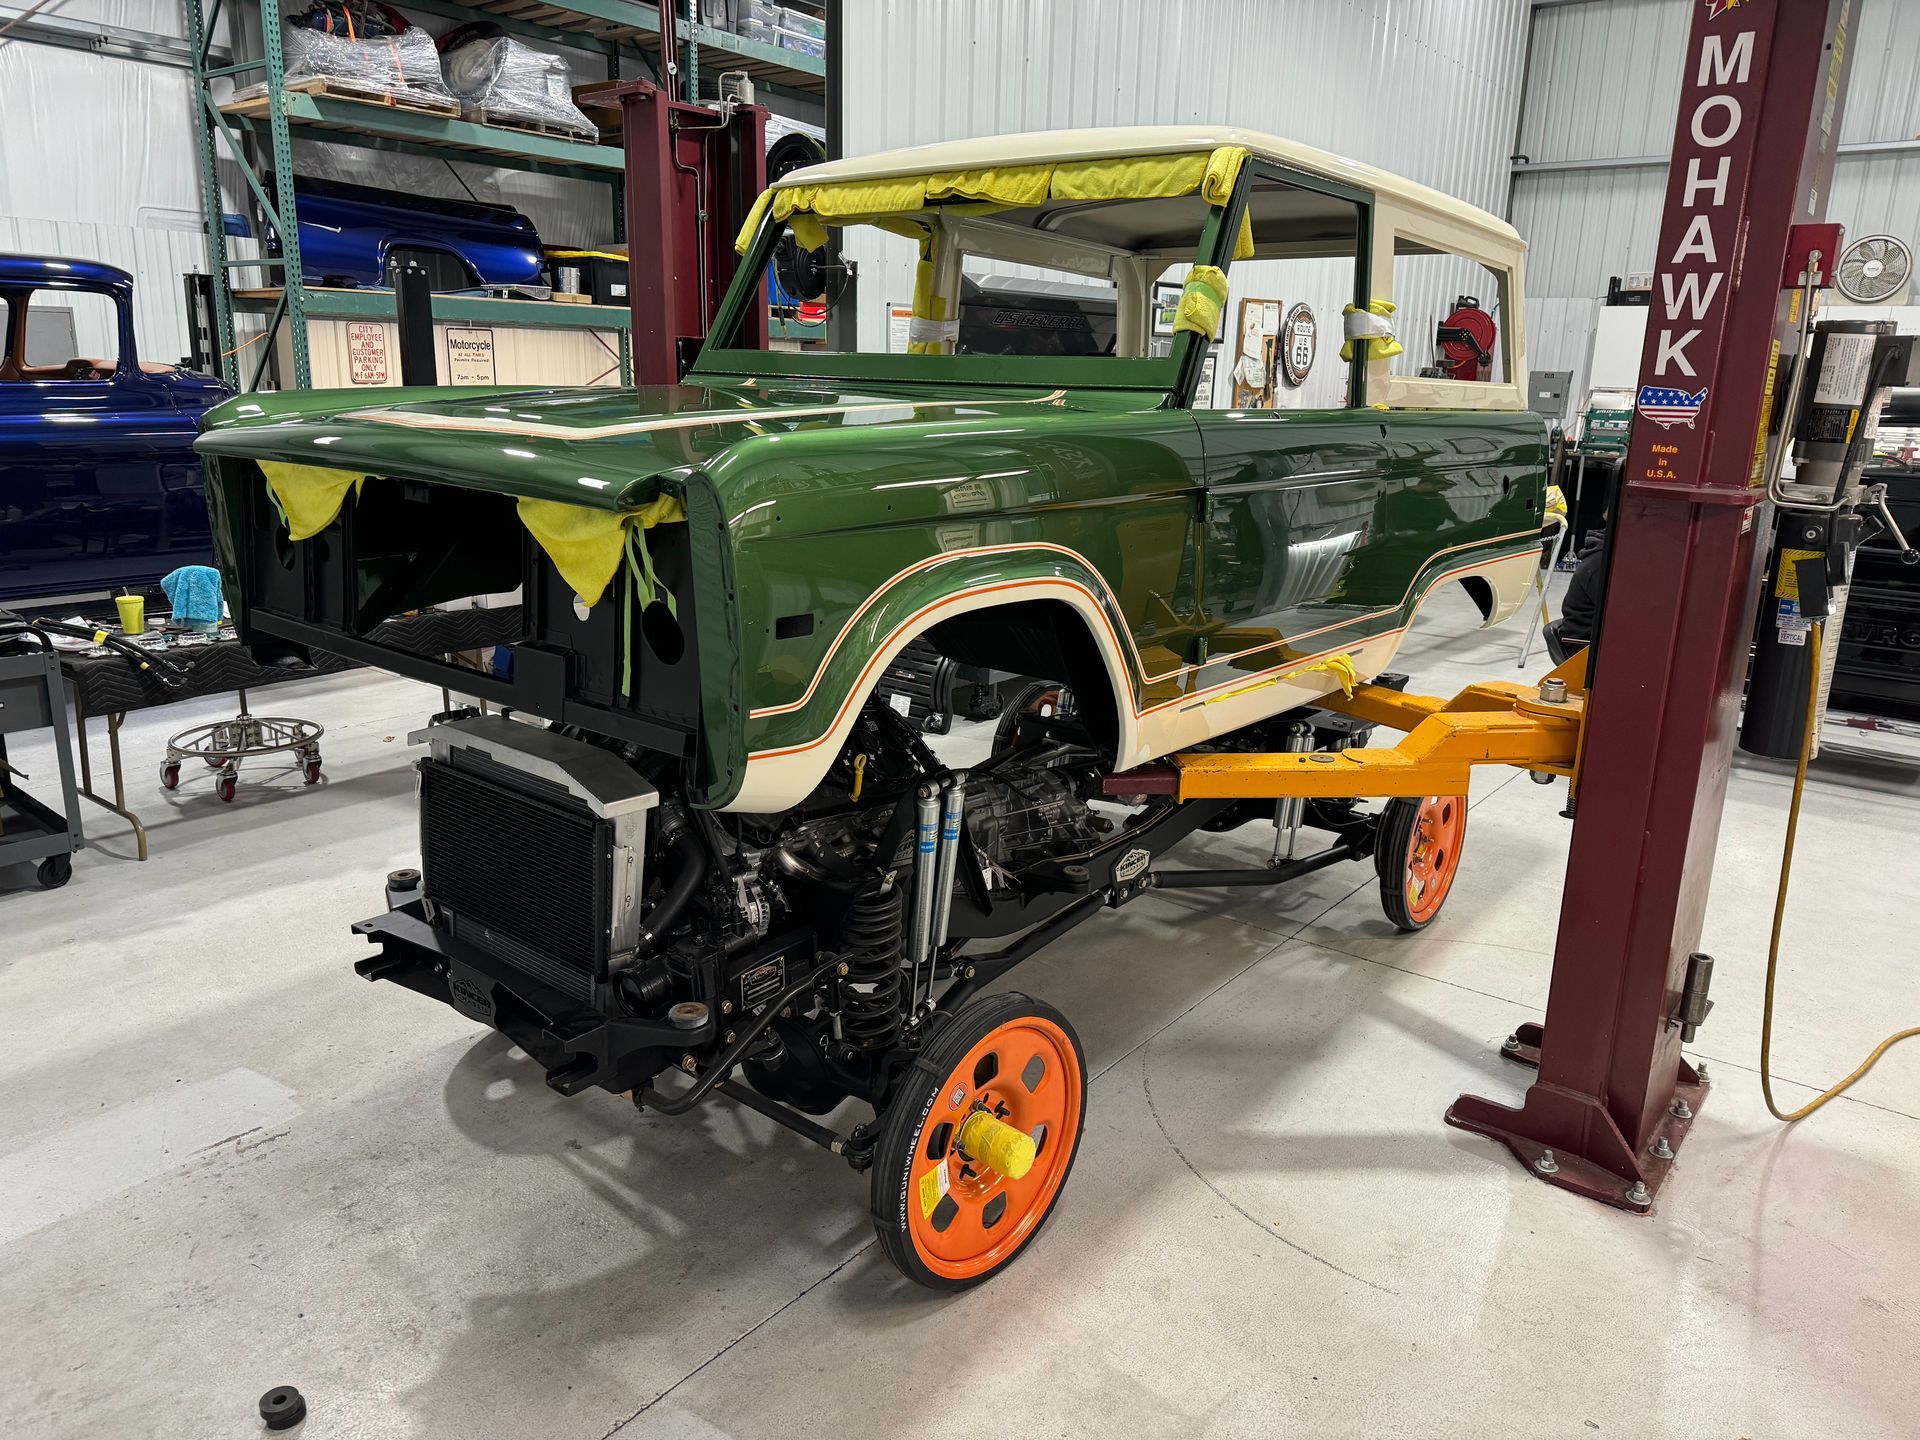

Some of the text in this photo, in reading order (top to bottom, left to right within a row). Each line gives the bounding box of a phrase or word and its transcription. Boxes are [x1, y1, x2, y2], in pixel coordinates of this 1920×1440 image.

[1654, 31, 1756, 376] MOHAWK
[358, 325, 374, 333] CITY
[1297, 324, 1311, 334] ROUTE
[351, 333, 382, 341] EMPLOYEE
[361, 341, 374, 349] AND
[450, 338, 491, 352] Motorcycle
[352, 348, 384, 357] CUSTOMER
[1296, 346, 1308, 365] 66
[354, 356, 384, 364] PARKING
[361, 364, 377, 372] ONLY
[1652, 444, 1678, 453] Made
[1646, 469, 1677, 479] U.S.A.
[1780, 632, 1804, 641] VERTICAL
[900, 1087, 940, 1233] WWW.GUNIWHEEL.COM
